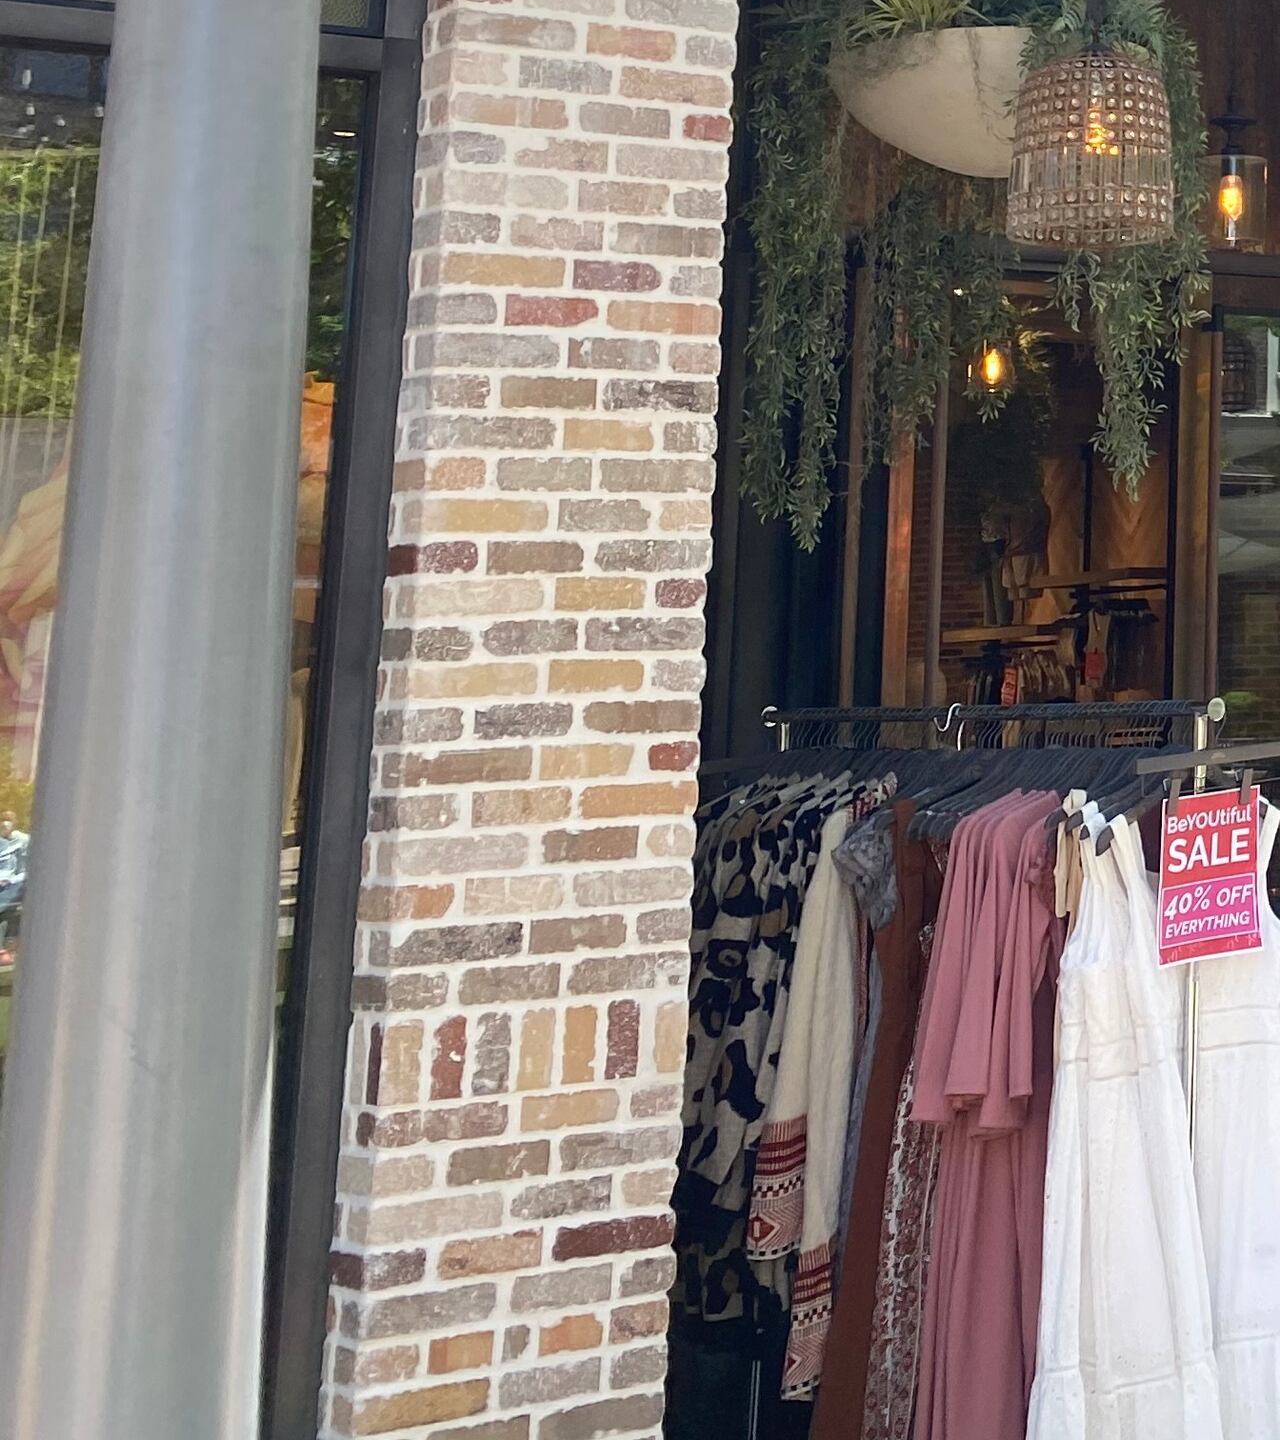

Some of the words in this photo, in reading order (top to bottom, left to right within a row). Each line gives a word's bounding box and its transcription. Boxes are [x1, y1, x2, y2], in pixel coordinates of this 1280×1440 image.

[1167, 804, 1252, 835] BeYOUtiful
[1168, 827, 1250, 873] SALE
[1164, 884, 1211, 920] 40%
[1216, 883, 1254, 907] OFF
[1165, 910, 1250, 939] EVERYTHING
